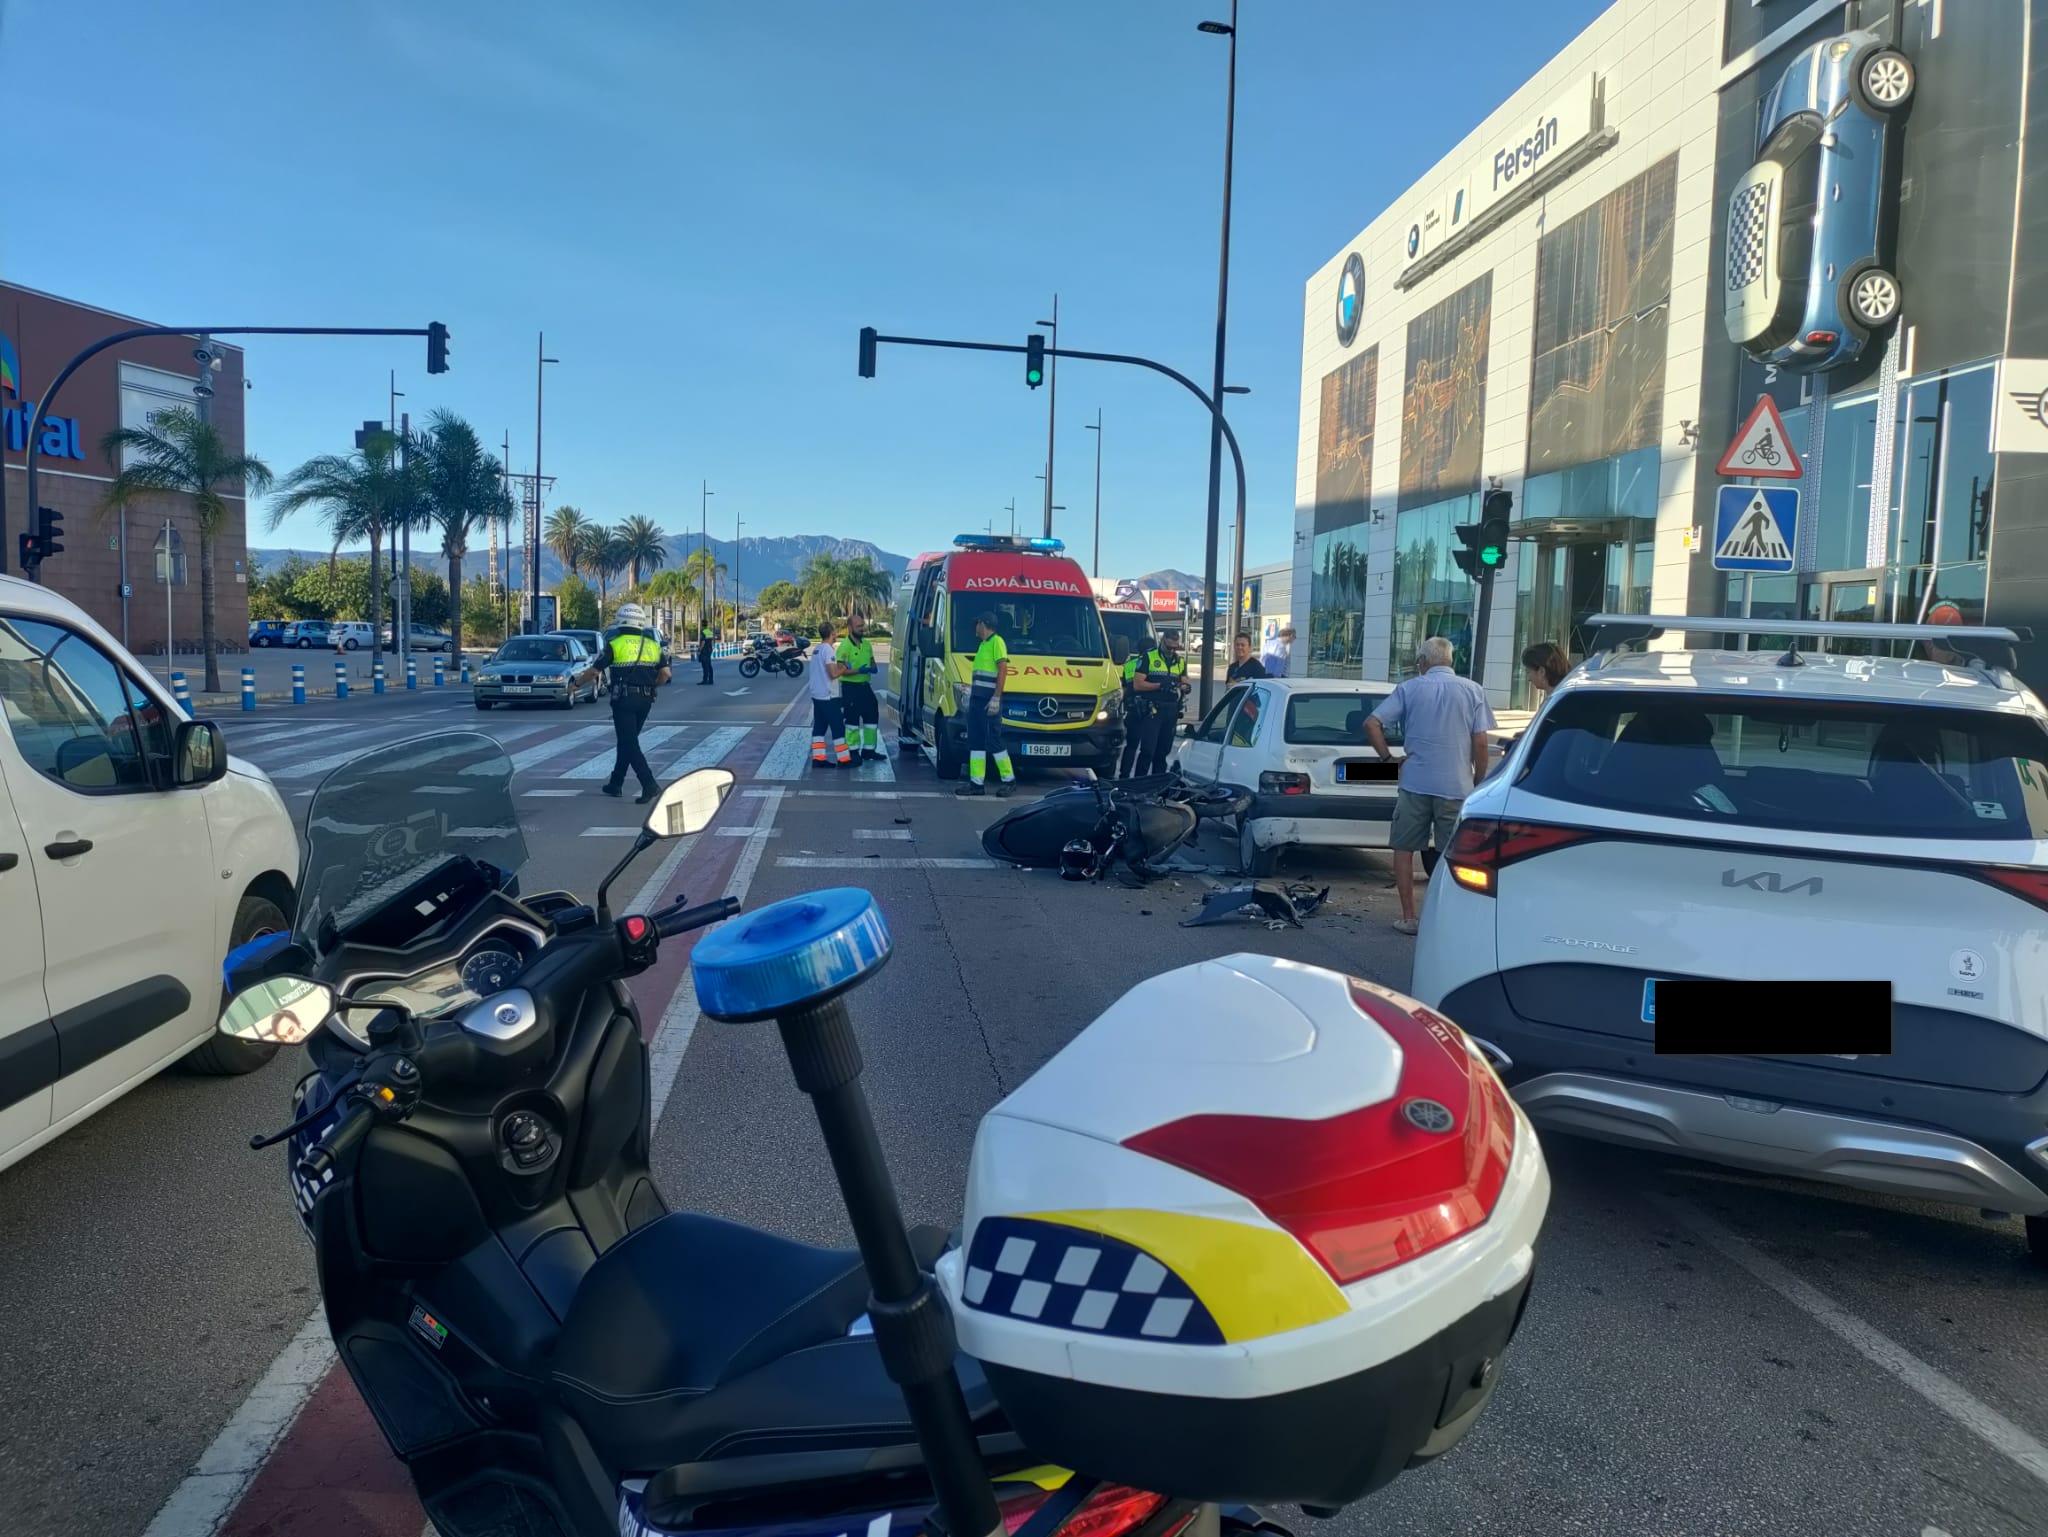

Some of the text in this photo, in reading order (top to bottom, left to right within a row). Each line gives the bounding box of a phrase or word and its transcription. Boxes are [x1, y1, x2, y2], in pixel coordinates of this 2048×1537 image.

[1493, 116, 1557, 191] Fersán
[1006, 666, 1083, 678] SAMU
[1029, 745, 1050, 754] 1968
[1542, 935, 1639, 954] SPORTAGE
